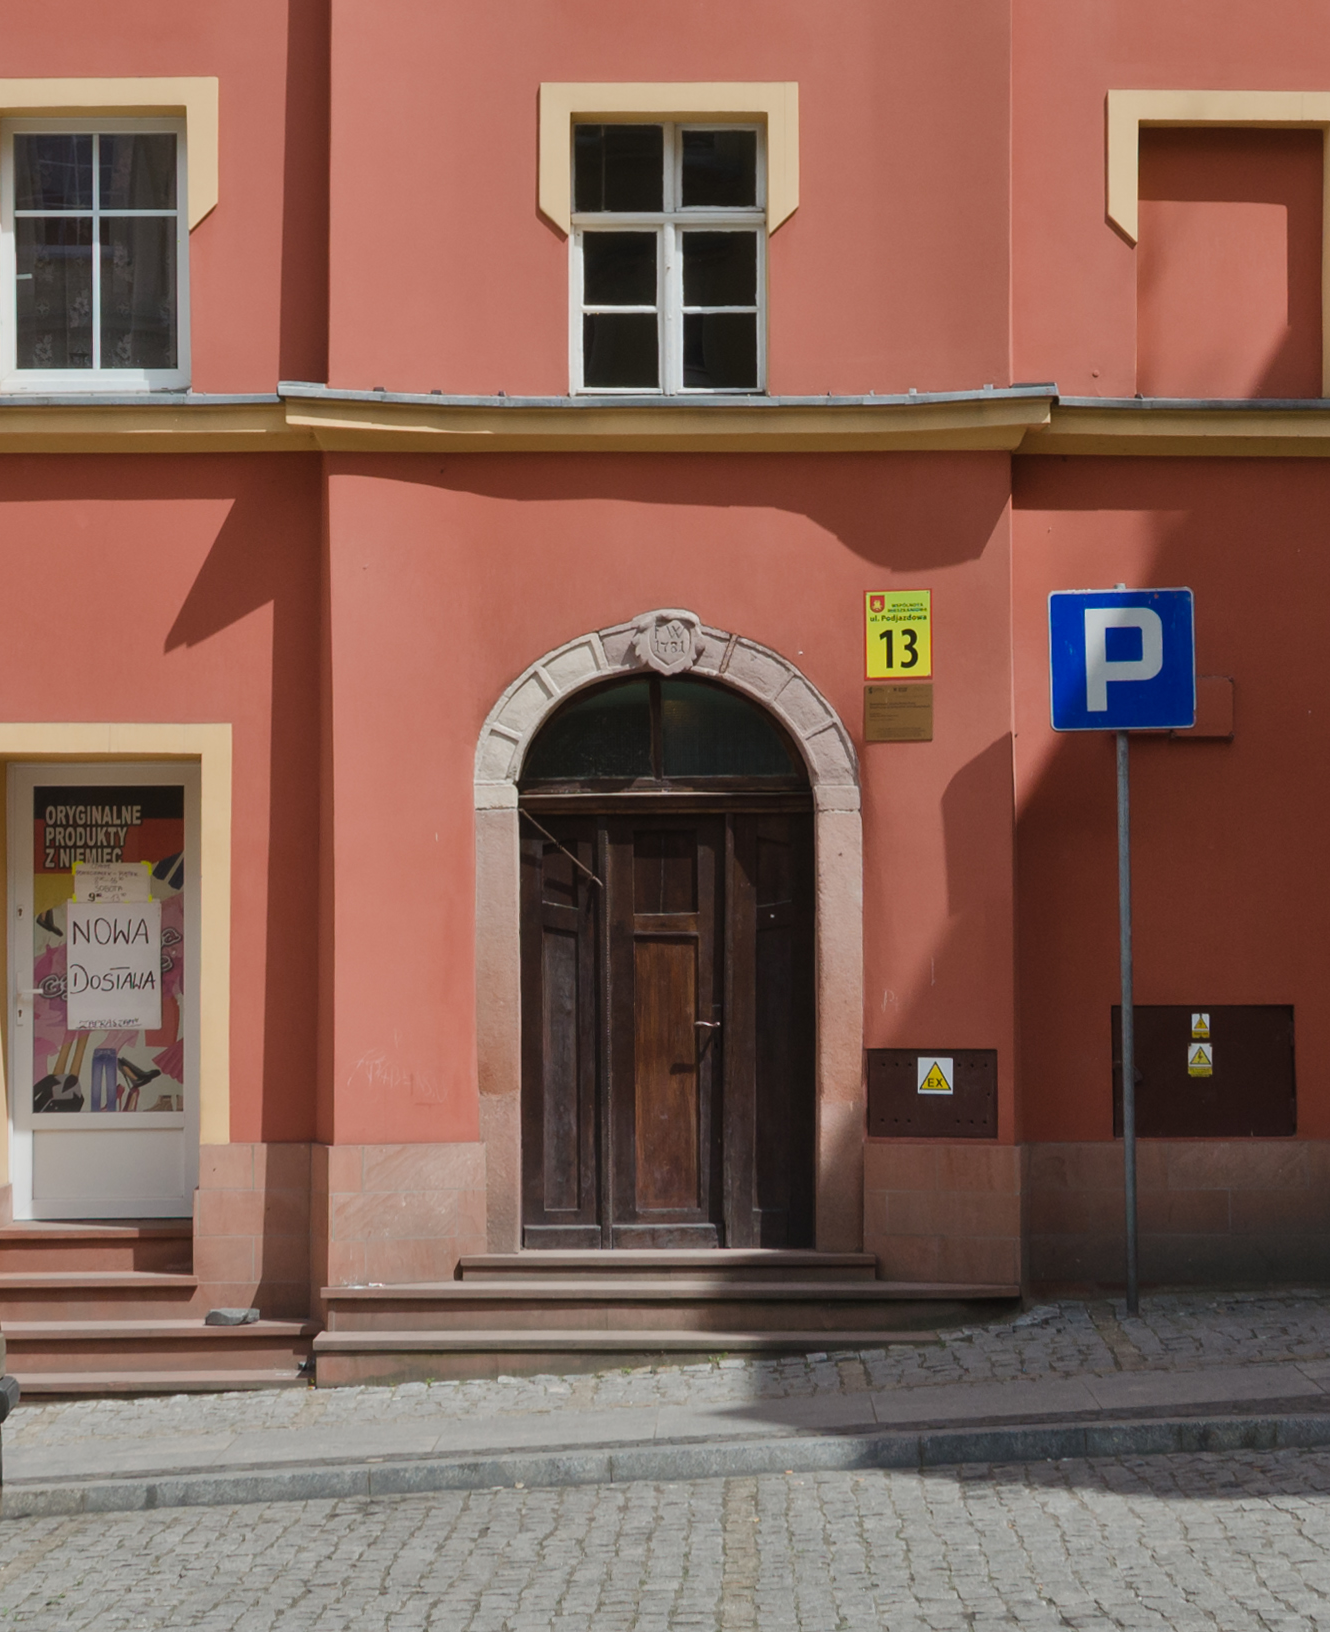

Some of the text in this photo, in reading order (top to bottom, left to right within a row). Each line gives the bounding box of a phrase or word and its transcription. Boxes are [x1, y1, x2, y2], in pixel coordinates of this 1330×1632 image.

[869, 613, 928, 623] ul. Podjazdowa
[879, 628, 919, 669] 13
[1084, 607, 1163, 712] P
[44, 805, 143, 825] ORYGINALNE
[44, 826, 128, 846] PRODUKTY
[44, 848, 56, 868] Z
[72, 917, 150, 945] NOWA
[927, 1077, 944, 1088] EX
